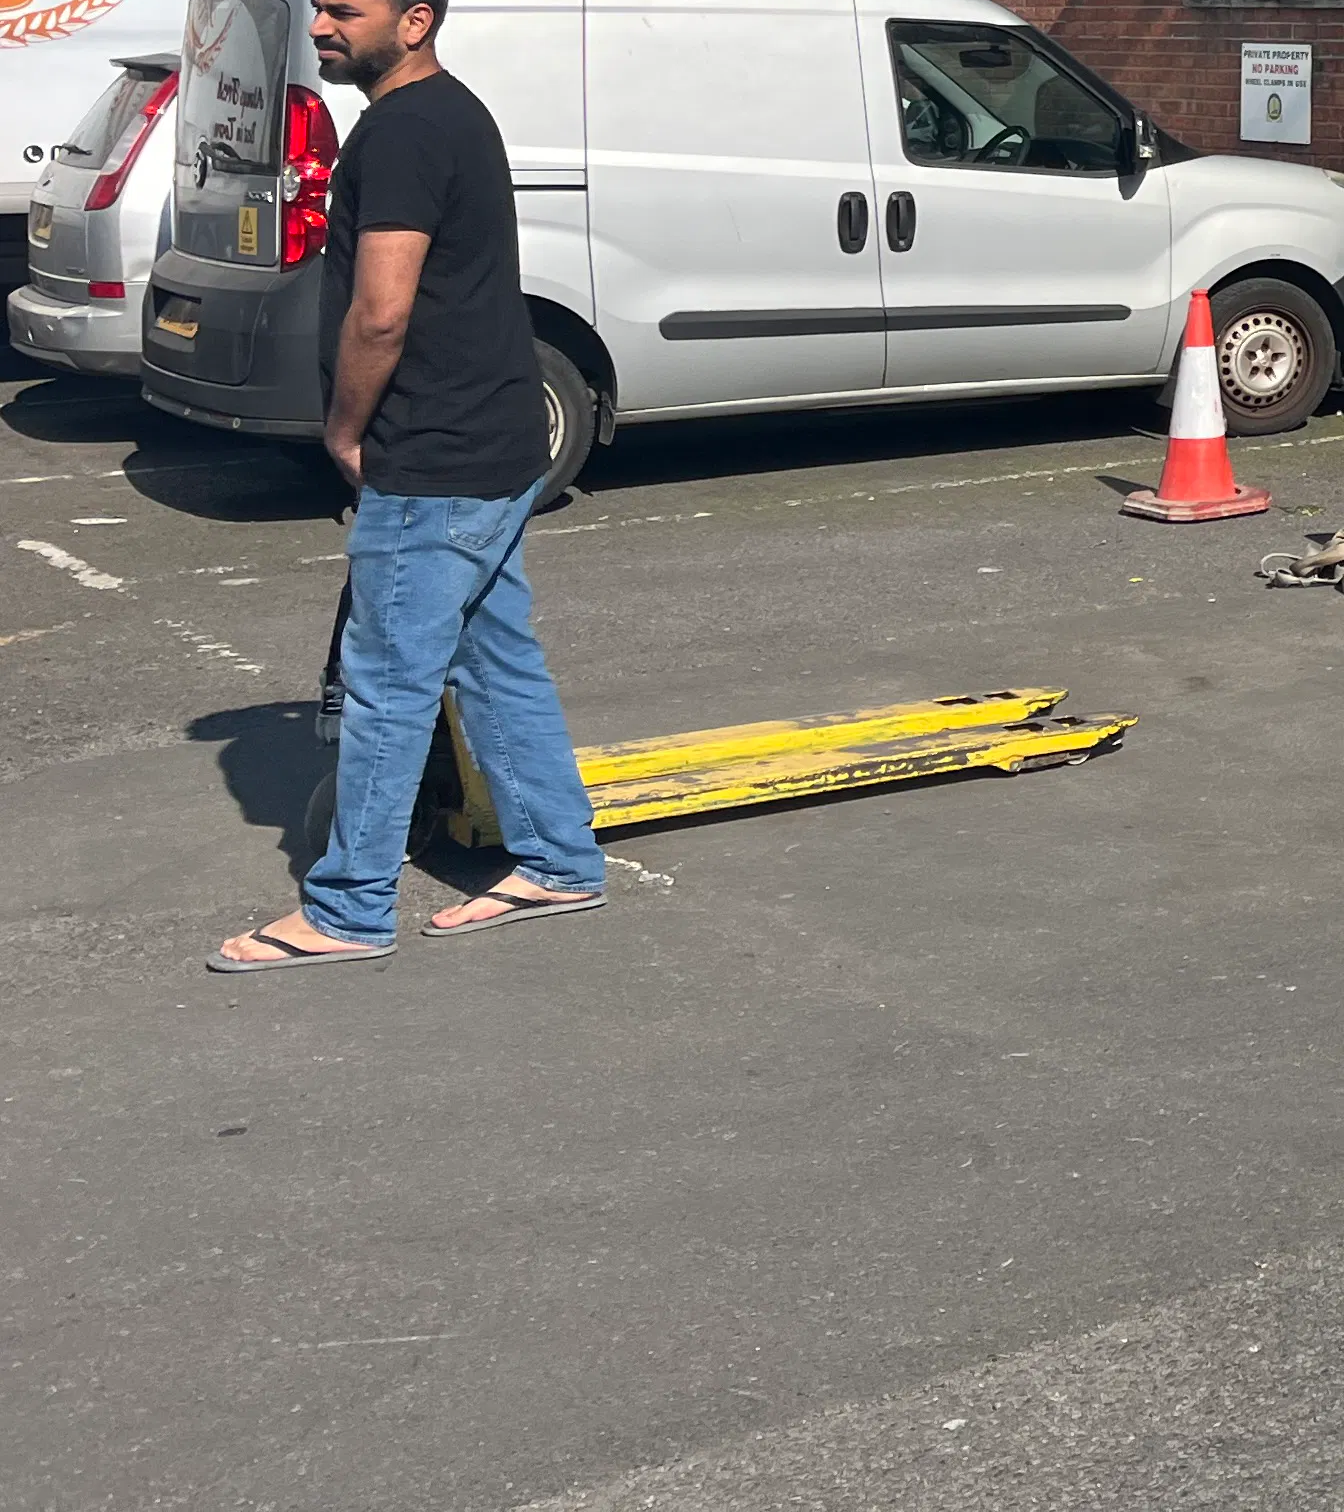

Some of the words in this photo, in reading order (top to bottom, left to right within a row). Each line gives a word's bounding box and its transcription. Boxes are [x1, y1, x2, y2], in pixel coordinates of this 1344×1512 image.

[1243, 50, 1271, 60] PRIVATE
[1272, 50, 1309, 61] PROPERTY
[1252, 64, 1262, 73] NO
[1265, 64, 1299, 75] PARKING
[1263, 79, 1286, 87] CLAMPS
